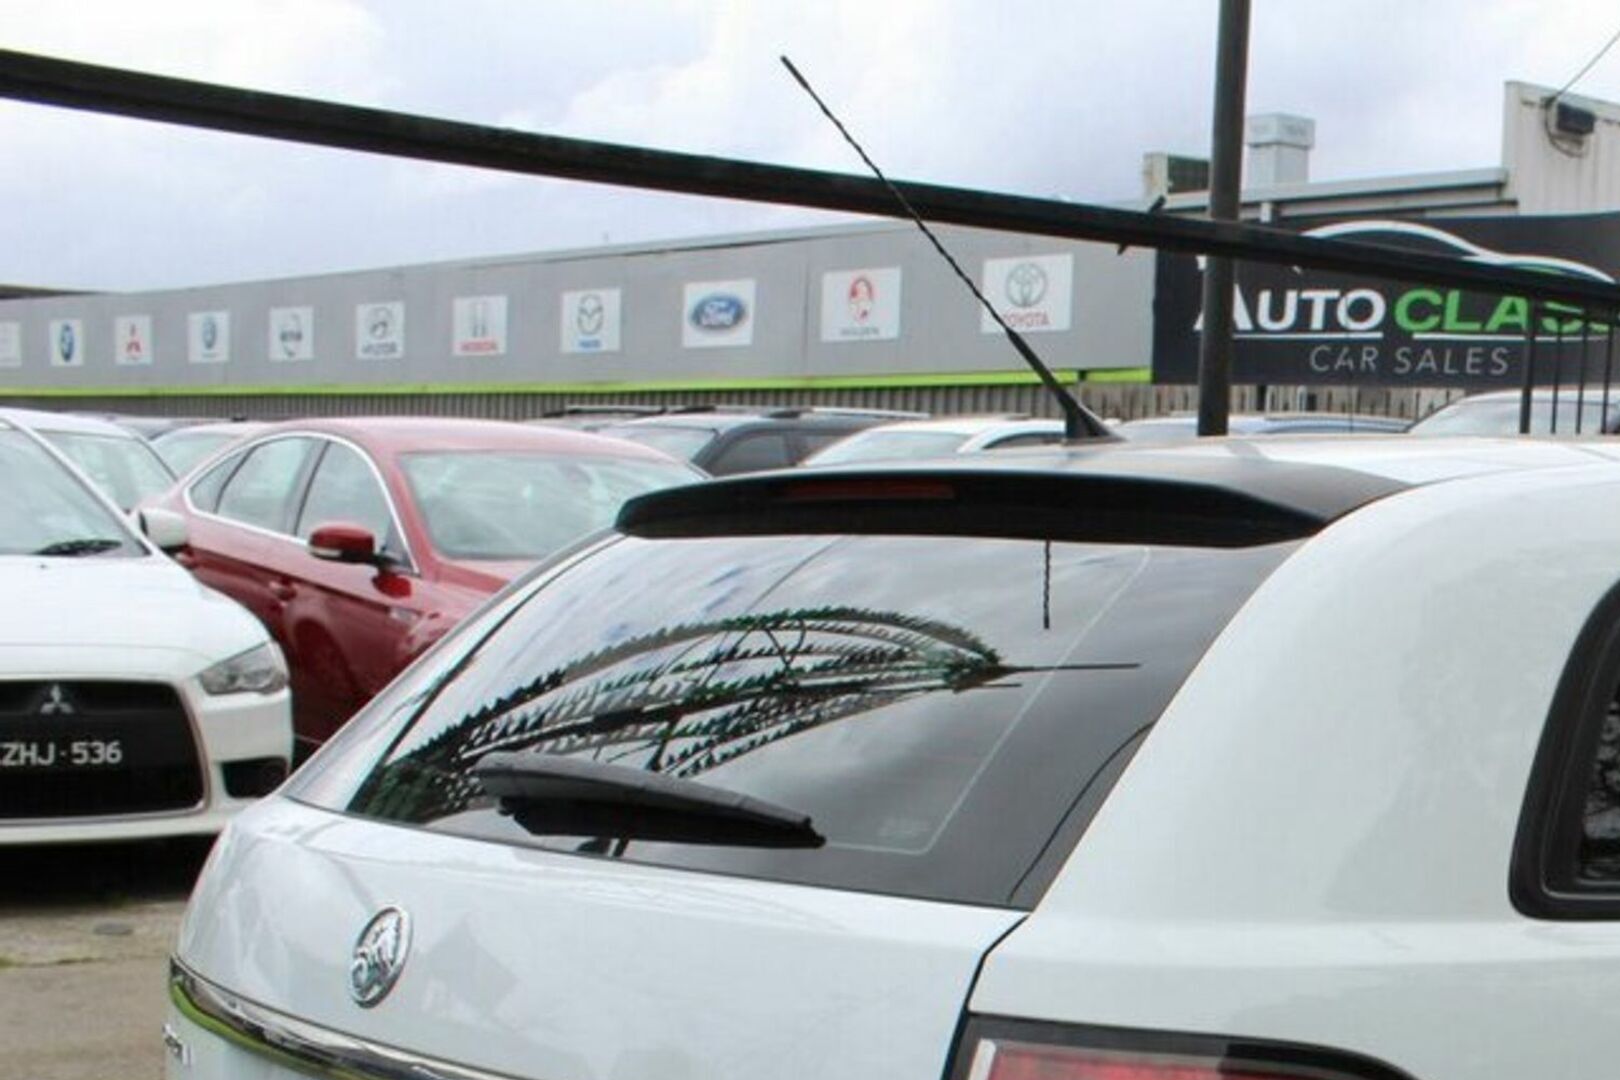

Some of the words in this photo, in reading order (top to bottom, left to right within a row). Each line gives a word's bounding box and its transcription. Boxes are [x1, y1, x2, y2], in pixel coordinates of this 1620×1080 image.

[1394, 288, 1611, 333] CLAS
[1309, 345, 1379, 373] CAR
[1394, 346, 1510, 376] SALES
[71, 740, 122, 765] 536
